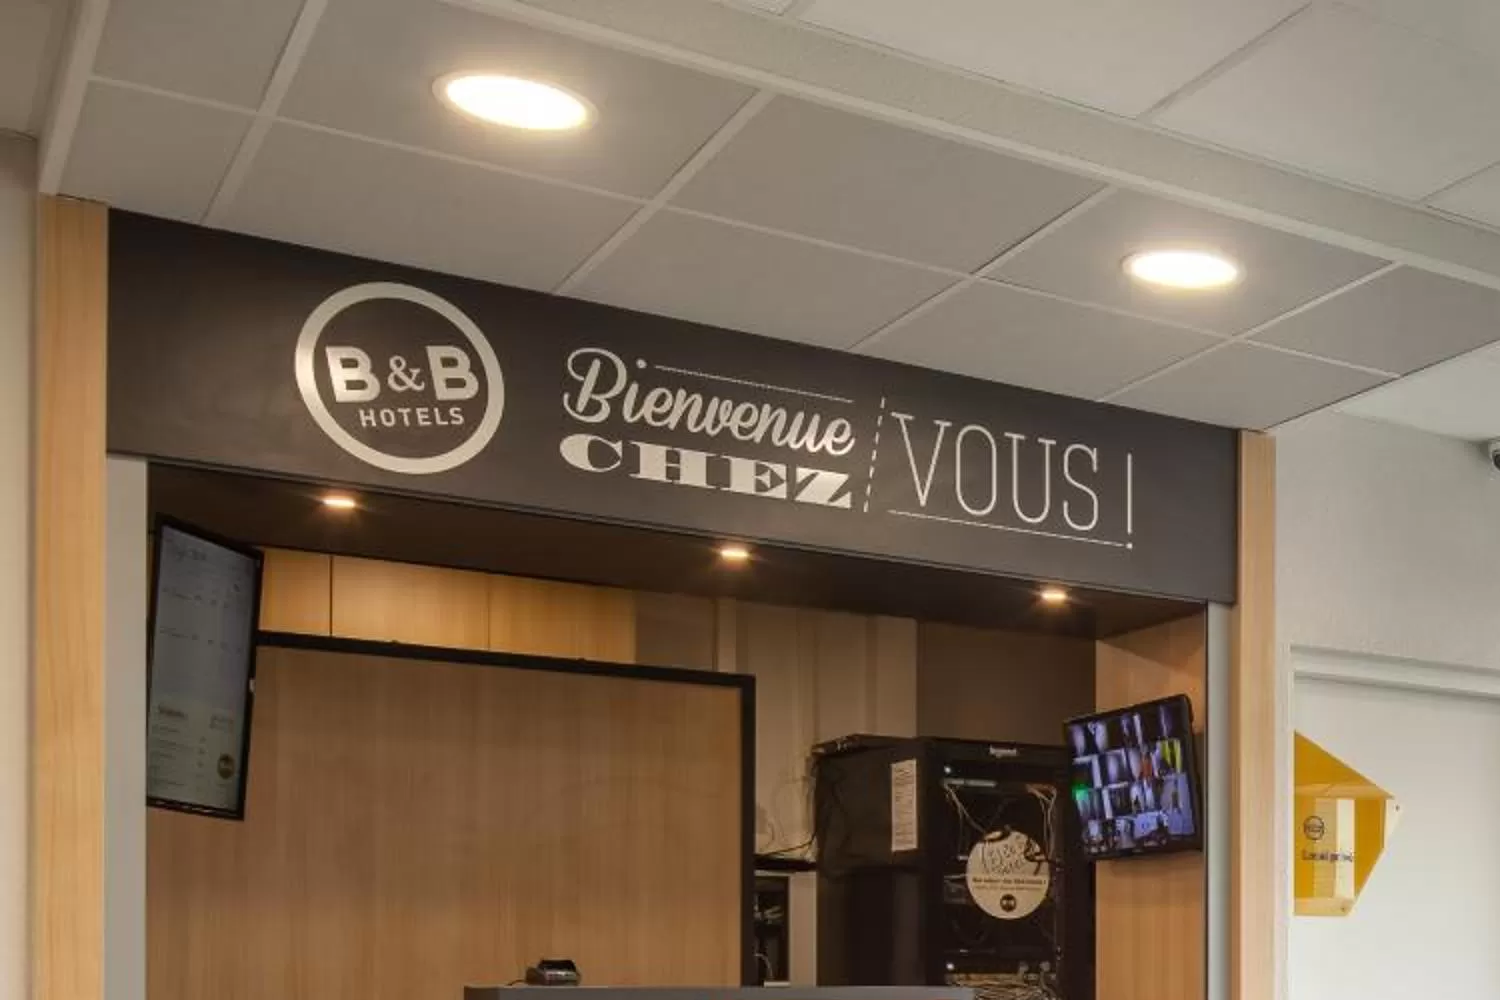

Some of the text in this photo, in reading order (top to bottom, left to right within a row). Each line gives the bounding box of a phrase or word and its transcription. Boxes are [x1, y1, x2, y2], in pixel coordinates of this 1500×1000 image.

[324, 345, 479, 403] B&B
[563, 347, 857, 458] Bienvenue
[358, 406, 465, 429] HOTELS
[559, 433, 853, 510] CHEZ
[890, 411, 1099, 531] VOUS
